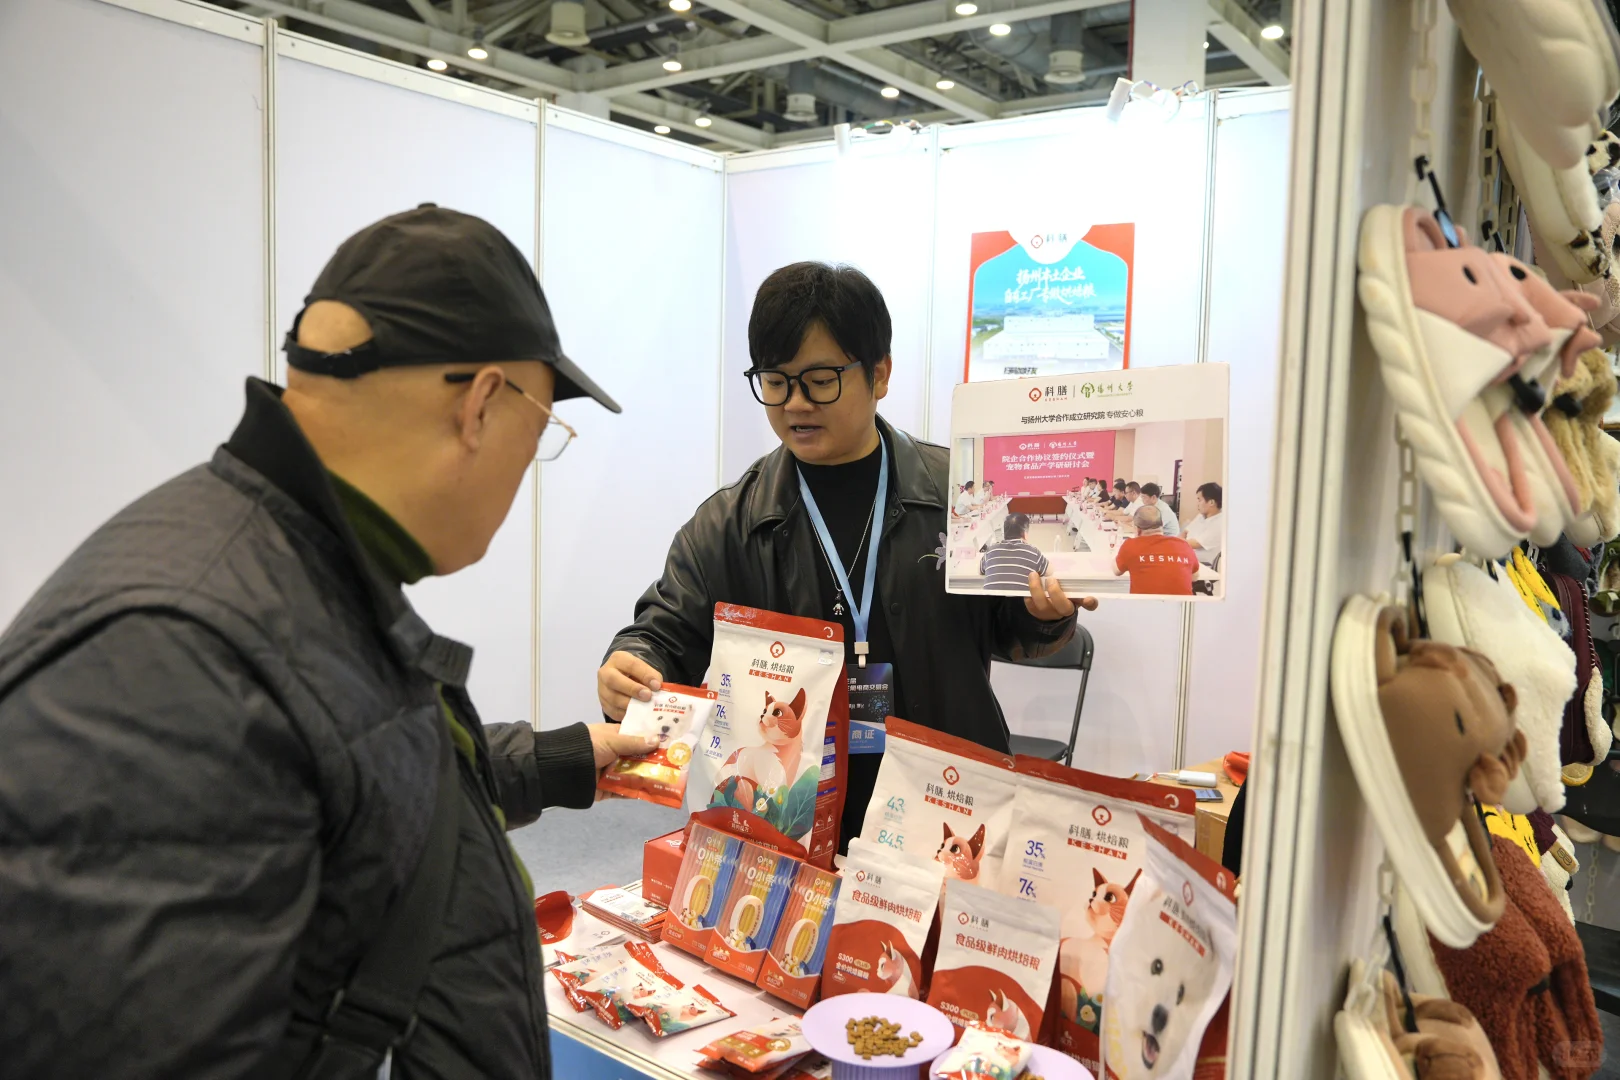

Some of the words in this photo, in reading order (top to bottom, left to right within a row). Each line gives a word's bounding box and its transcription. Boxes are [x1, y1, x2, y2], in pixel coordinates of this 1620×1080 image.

[1045, 385, 1067, 397] 科膳
[1021, 411, 1105, 425] 与扬州大学合作成立研究院
[1139, 555, 1189, 564] KESHAN
[751, 669, 790, 682] KESHAN
[927, 796, 970, 815] KESHAN
[1071, 838, 1125, 859] KESHAN
[852, 889, 923, 923] 食品级鲜肉烘焙粮
[837, 952, 854, 964] S300
[955, 932, 1041, 971] 食品级鲜肉烘焙粮
[940, 1001, 960, 1014] S300
